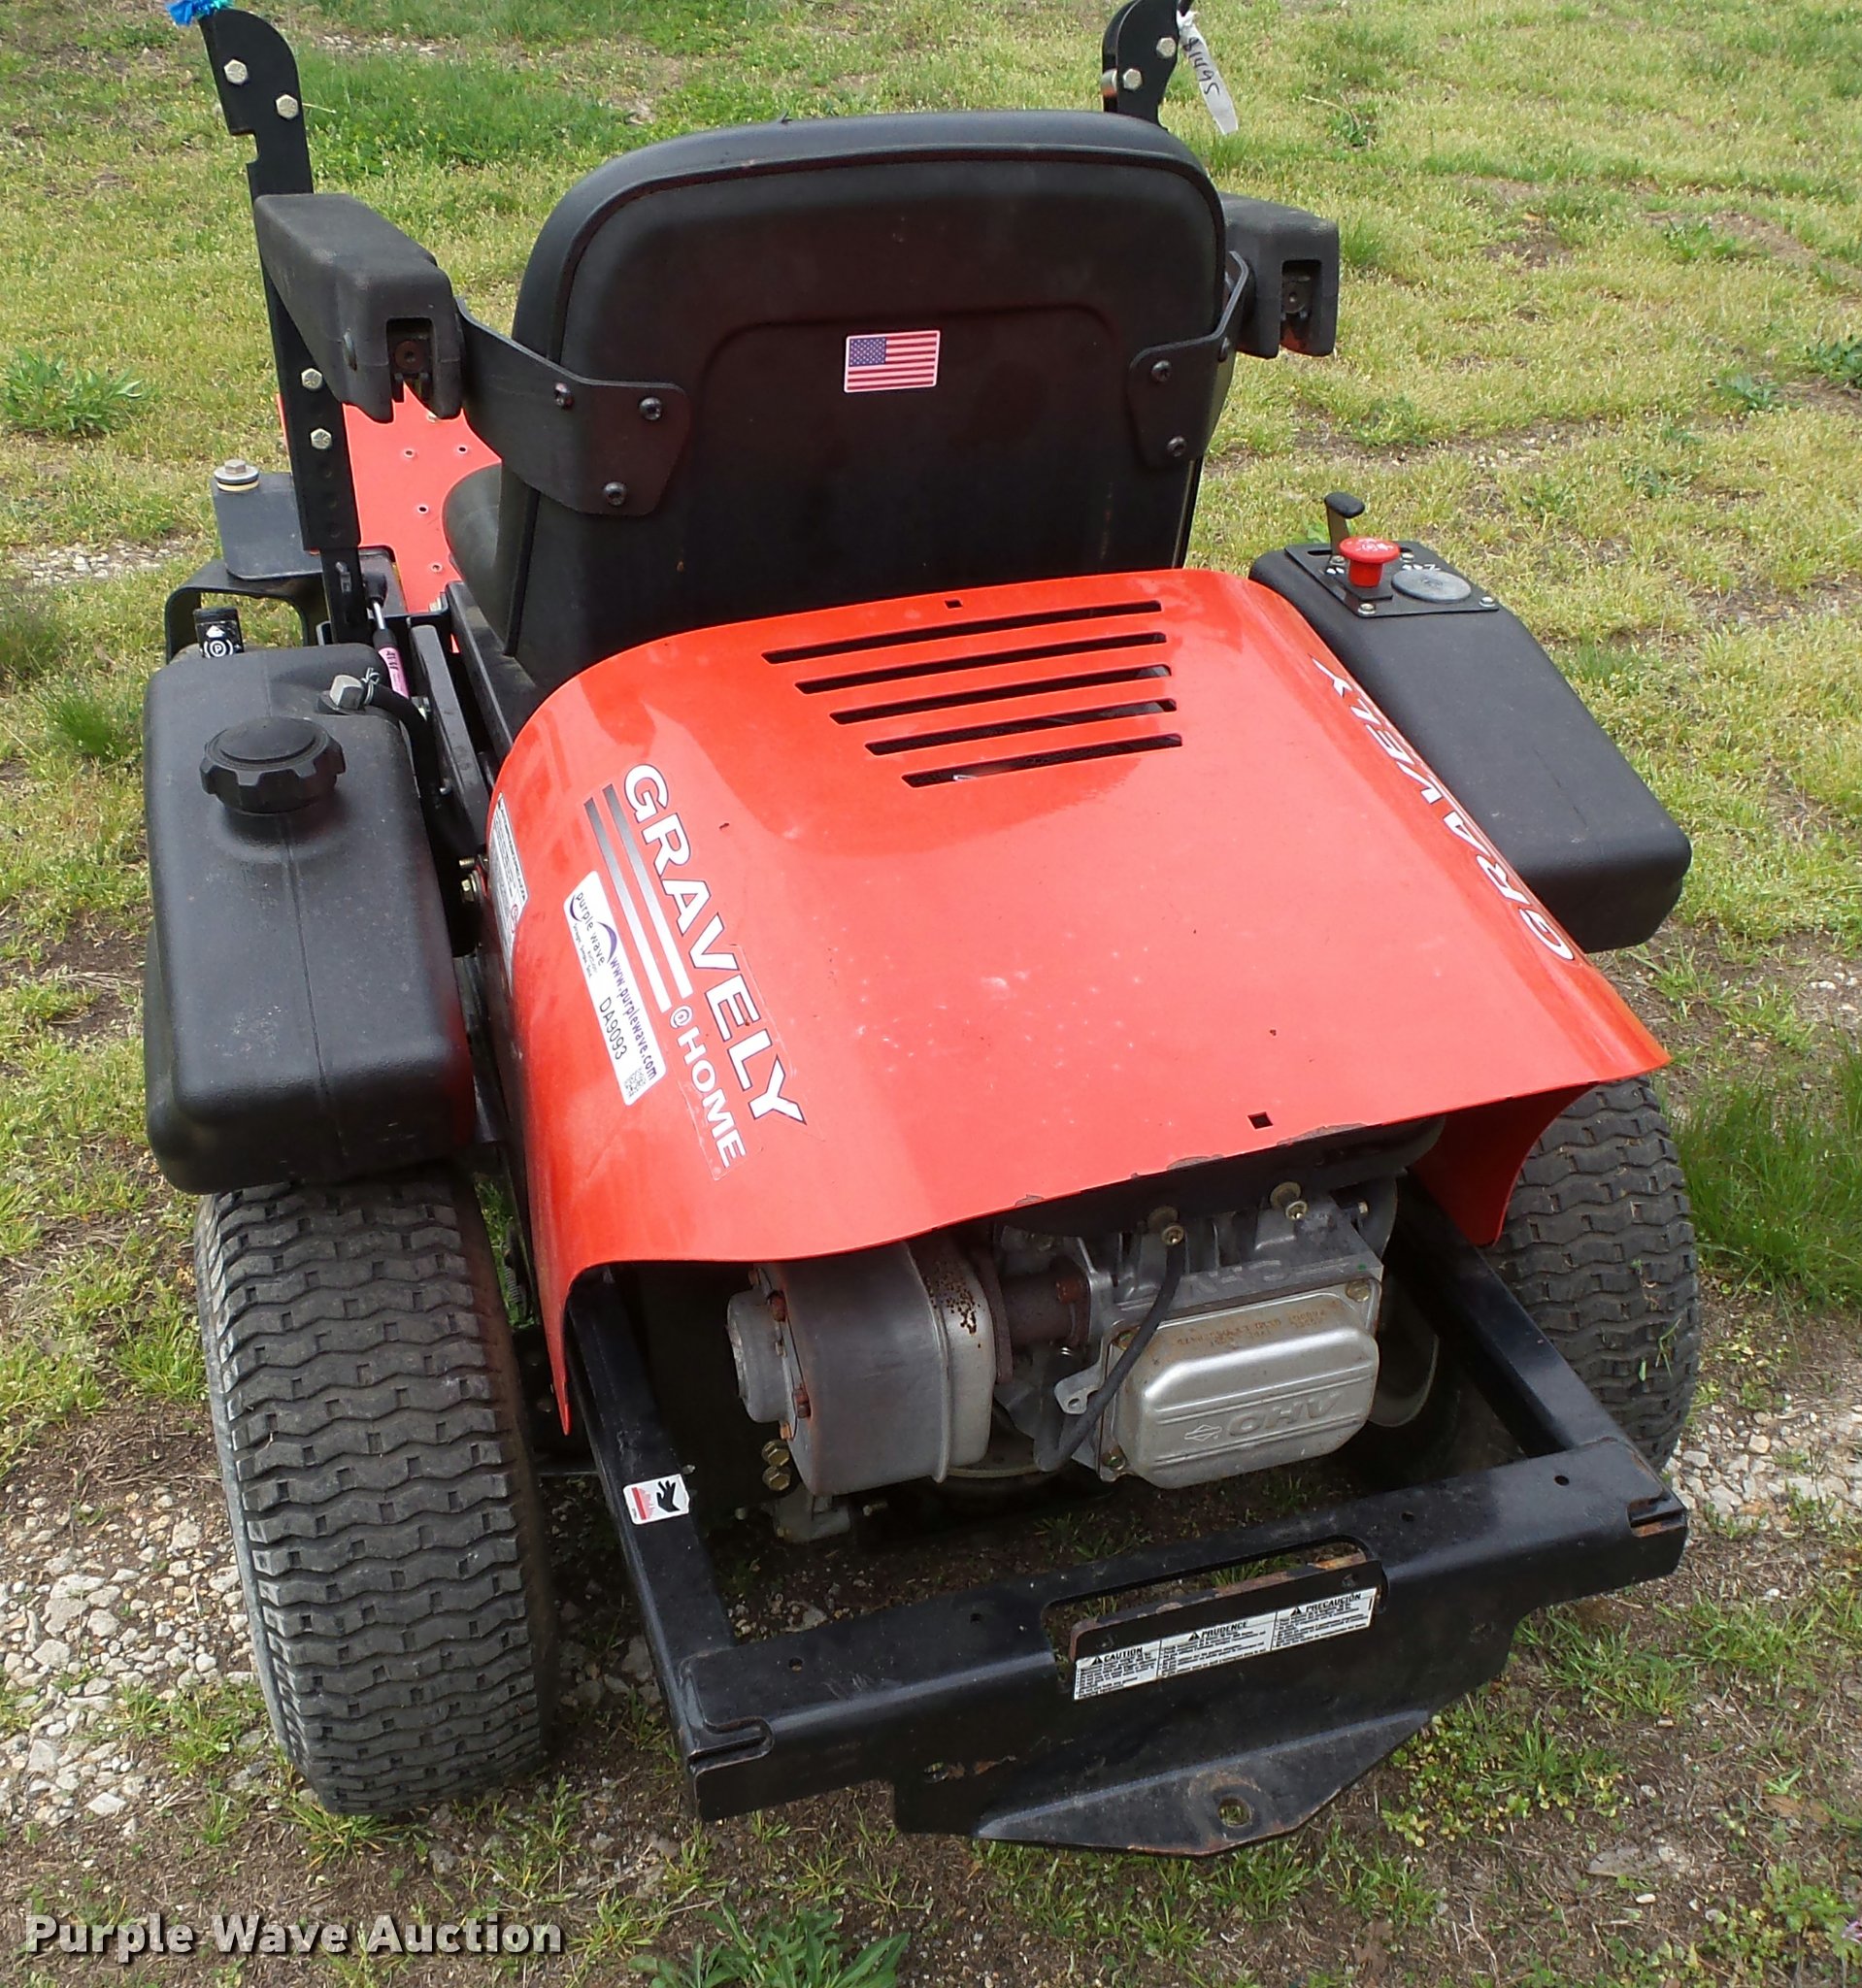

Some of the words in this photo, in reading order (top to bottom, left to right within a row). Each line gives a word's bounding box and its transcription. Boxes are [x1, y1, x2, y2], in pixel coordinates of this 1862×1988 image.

[576, 891, 594, 931] purple
[590, 932, 606, 967] wave
[623, 763, 808, 1125] GRAVELY
[599, 996, 628, 1060] DA9093
[610, 956, 657, 1081] www.purplewave.com
[1104, 1646, 1143, 1663] CAUTION
[1201, 1620, 1248, 1639] PRUDENCE
